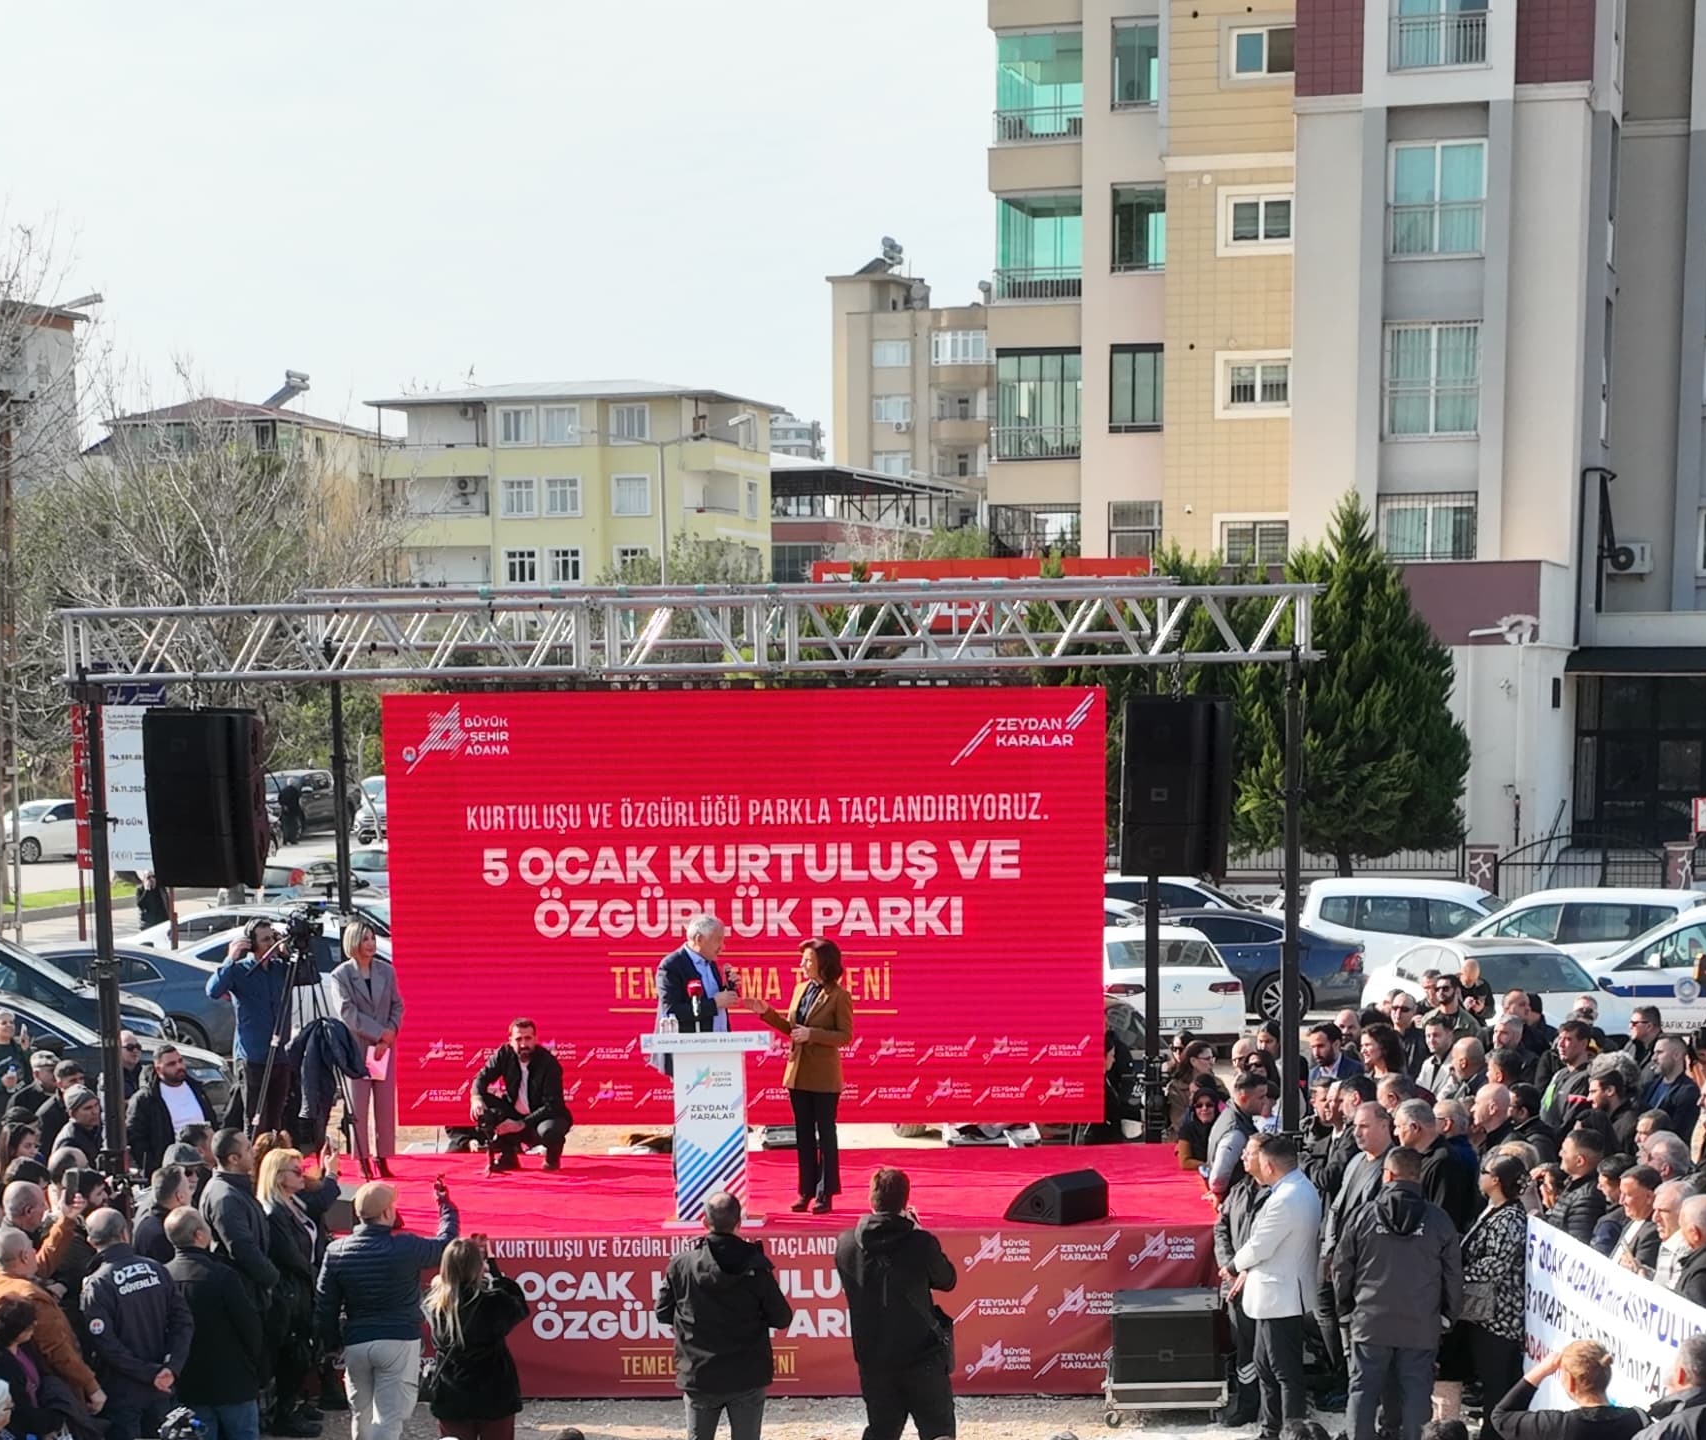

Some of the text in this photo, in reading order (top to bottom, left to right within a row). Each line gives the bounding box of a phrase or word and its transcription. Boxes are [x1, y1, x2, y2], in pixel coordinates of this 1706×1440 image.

[464, 715, 509, 728] BÜYÜK
[996, 718, 1062, 731] ZEYDAN
[469, 729, 509, 744] ŞEHİR
[996, 734, 1074, 747] KARALAR
[464, 744, 510, 756] ADANA
[466, 792, 1049, 834] KURTULUŞU VE ÖZGÜRLÜĞÜ PARKLA TAÇLANDIRIYORUZ.
[482, 839, 1021, 889] 5 OCAK KURTULUŞ VE
[810, 896, 963, 937] PARKI
[690, 1104, 729, 1112] ZEYDAN
[690, 1112, 736, 1120] KARALAR
[588, 1240, 608, 1257] VE
[1061, 1244, 1101, 1252] ZEYDAN
[1527, 1233, 1537, 1263] 5
[1539, 1240, 1568, 1283] OCAK
[113, 1263, 158, 1285] ÖZEL
[119, 1276, 161, 1295] GÜVENLİK
[515, 1271, 636, 1301] OCAK
[978, 1299, 1019, 1307] ZEYDAN
[978, 1307, 1026, 1315] KARALAR
[1538, 1290, 1567, 1333] MART
[533, 1302, 676, 1340] ÖZGÜR
[622, 1356, 676, 1375] TEMEL
[1061, 1361, 1108, 1369] KARALAR
